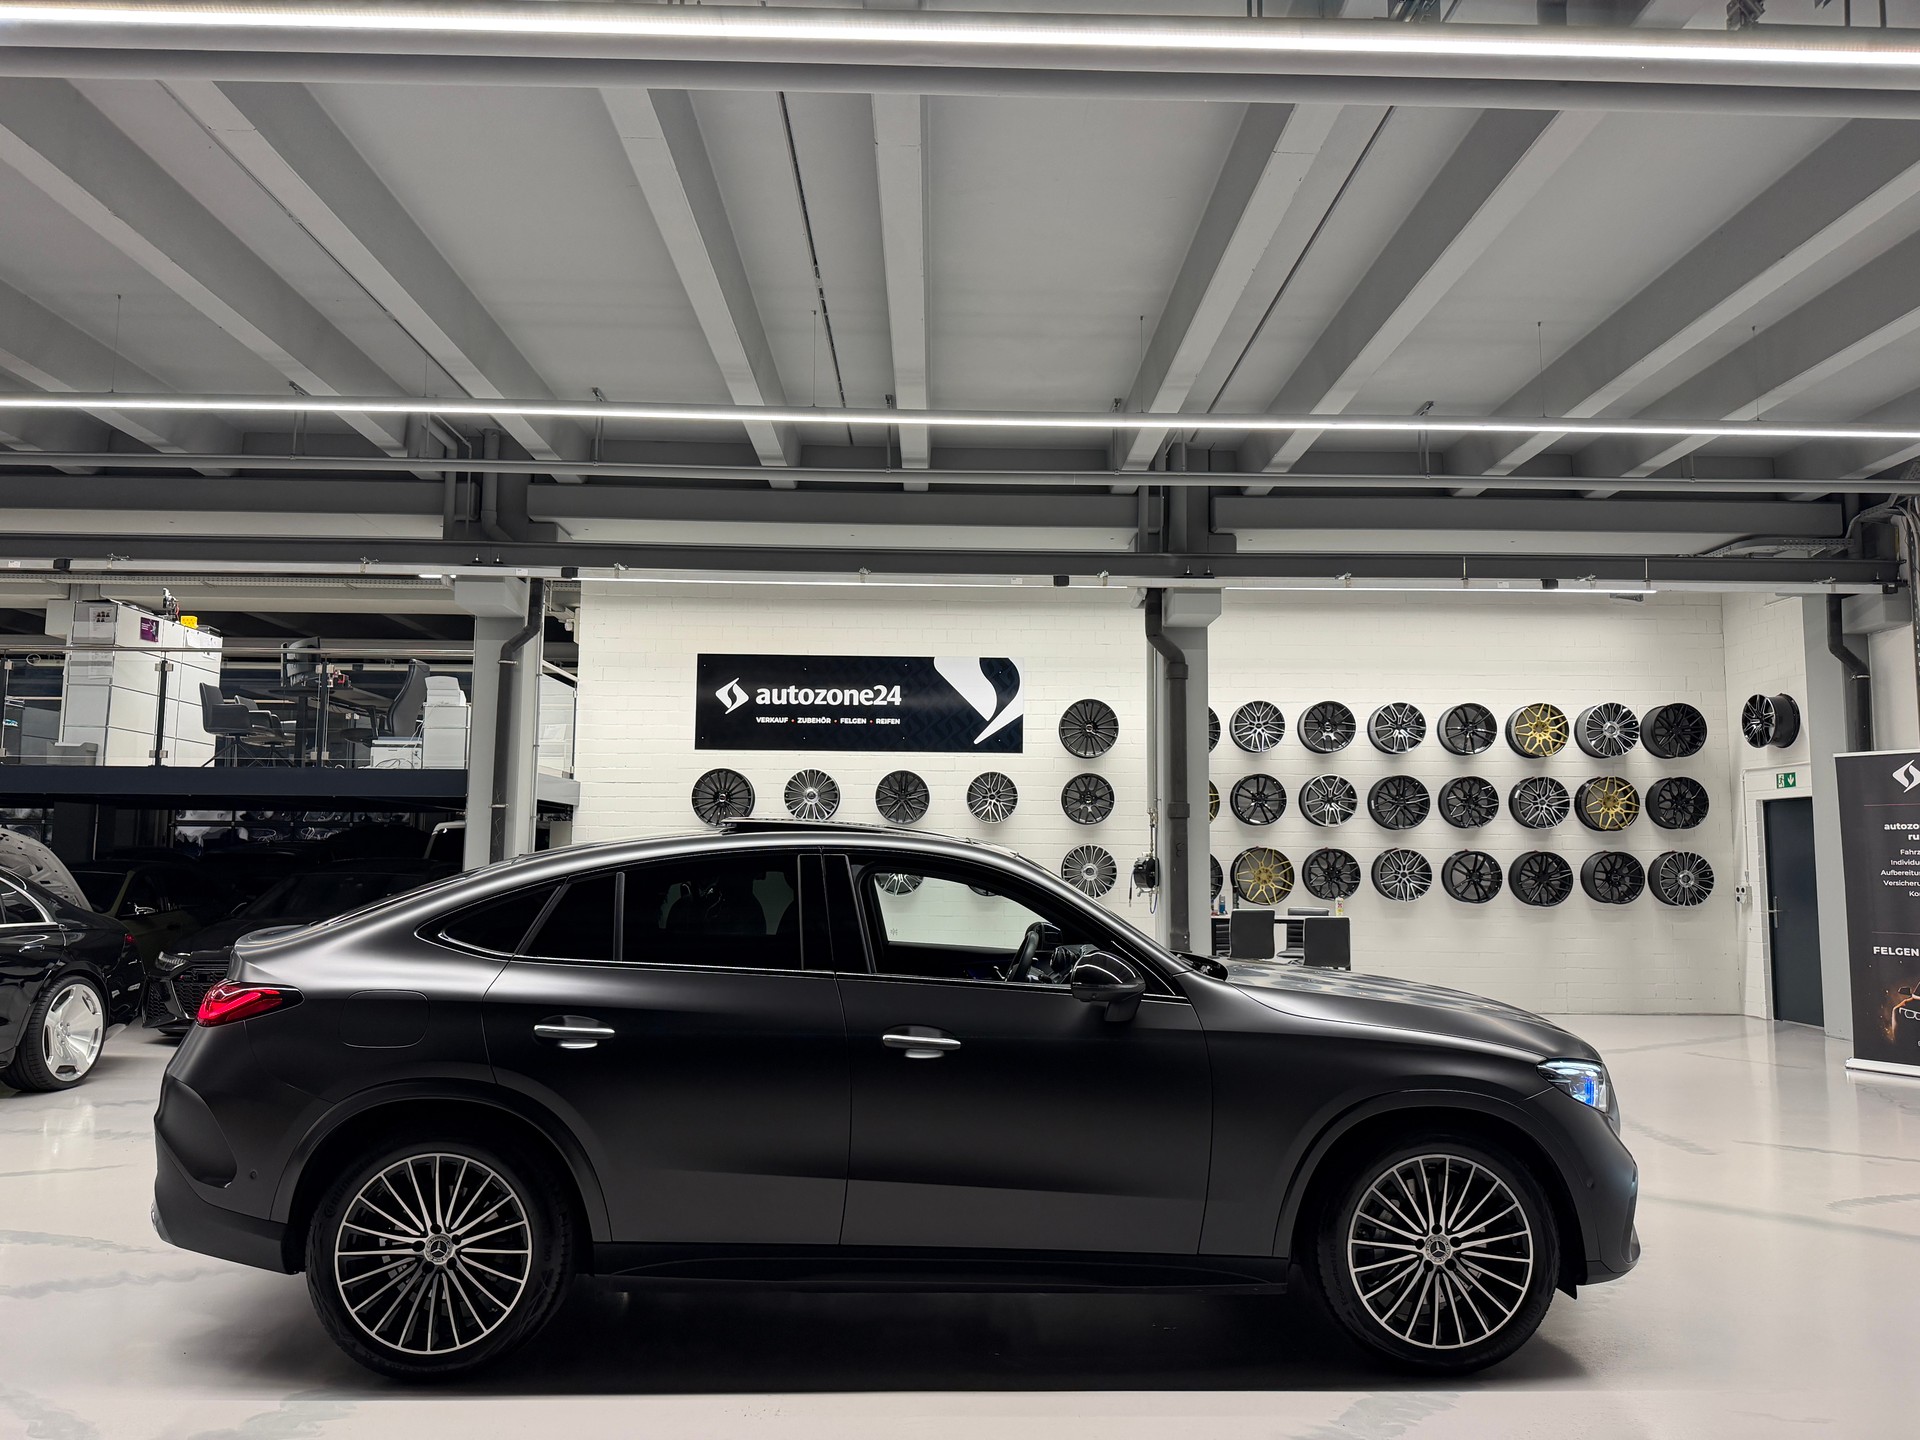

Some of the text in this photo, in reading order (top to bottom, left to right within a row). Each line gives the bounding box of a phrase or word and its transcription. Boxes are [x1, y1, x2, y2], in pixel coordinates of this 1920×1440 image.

[755, 684, 902, 706] autozone24
[756, 716, 788, 724] VERKAUF
[797, 716, 831, 724] ZUBEHÖR
[1873, 946, 1920, 956] FELGEN
